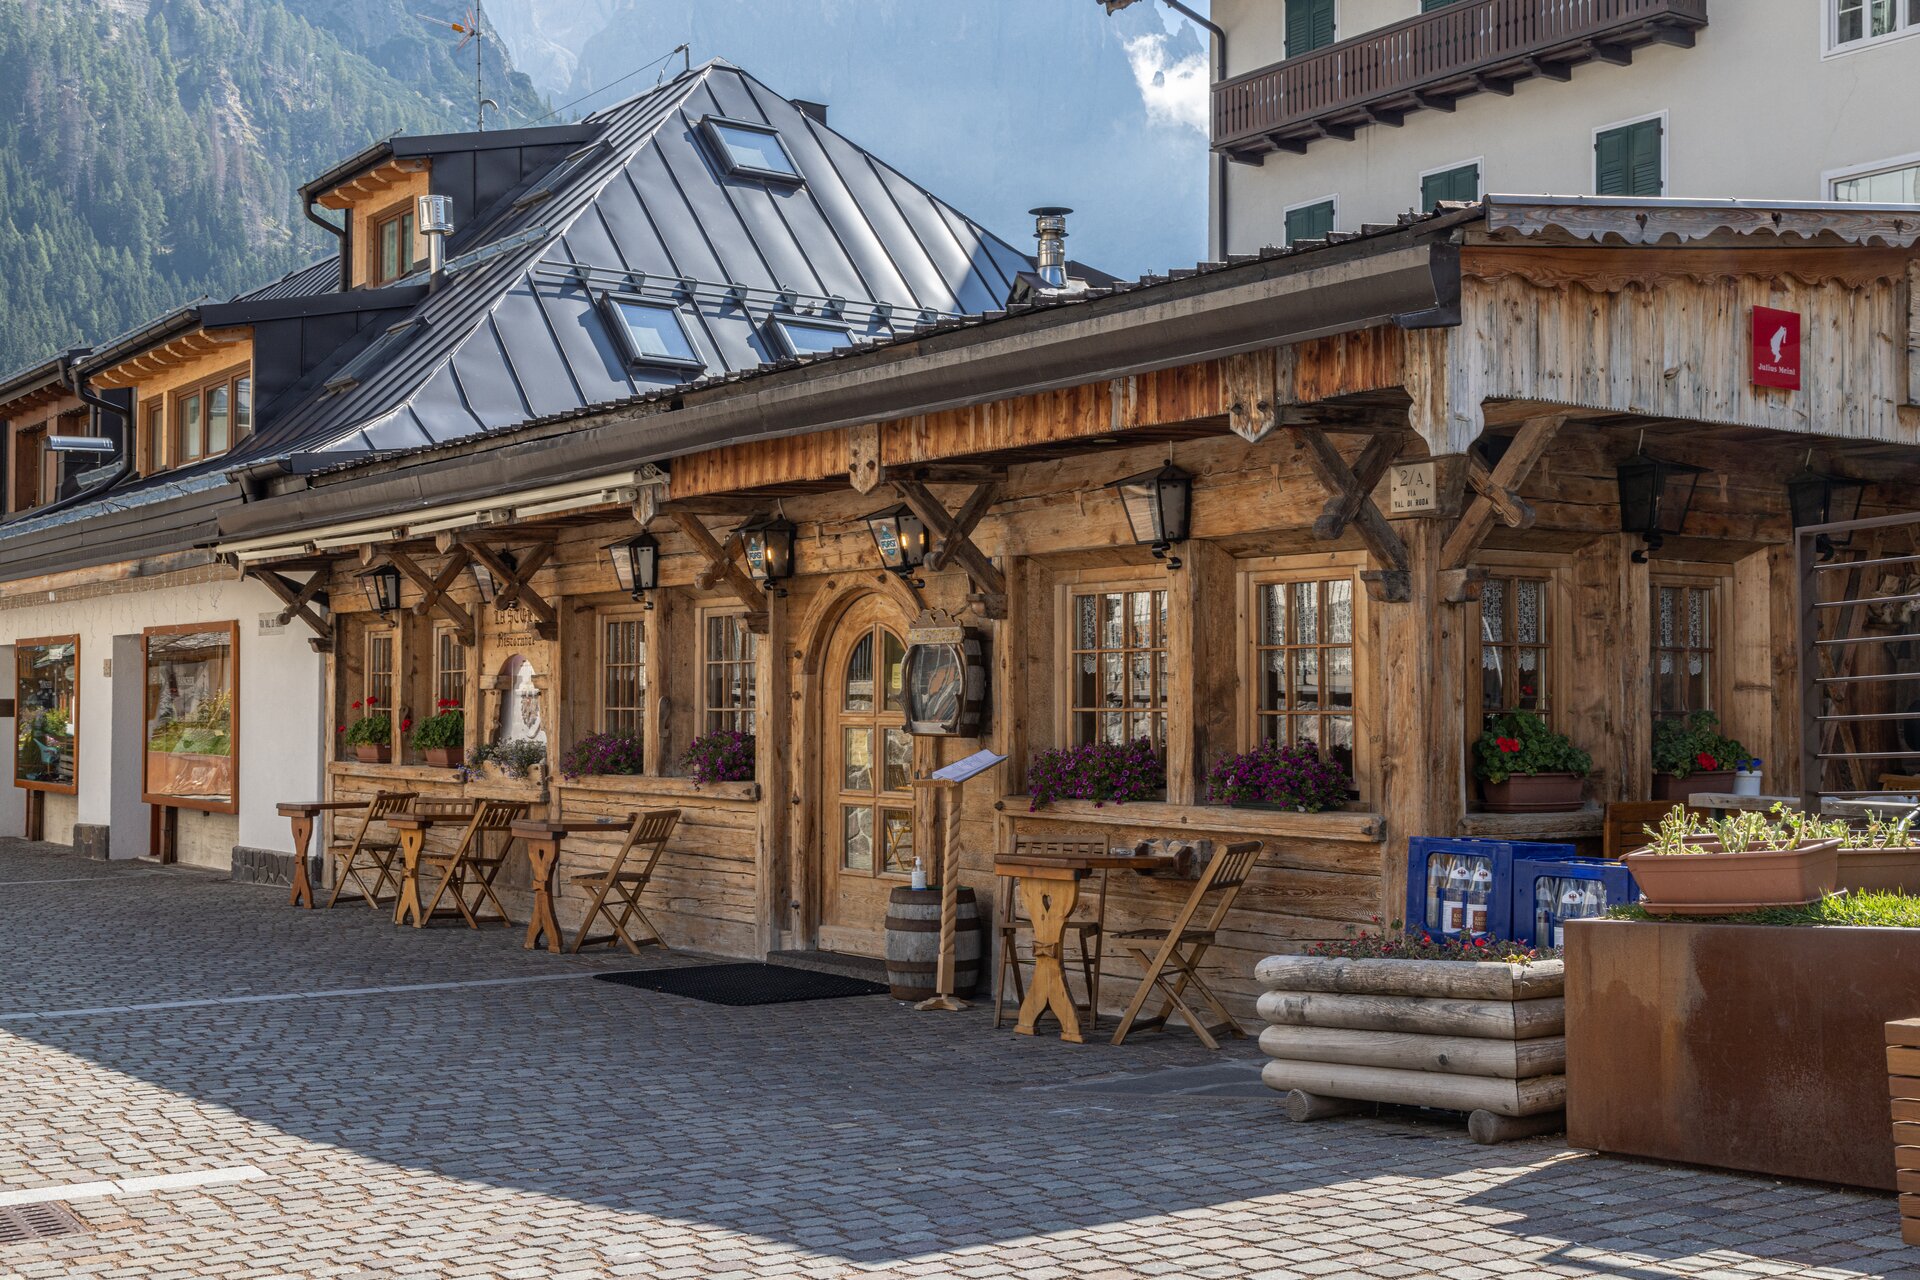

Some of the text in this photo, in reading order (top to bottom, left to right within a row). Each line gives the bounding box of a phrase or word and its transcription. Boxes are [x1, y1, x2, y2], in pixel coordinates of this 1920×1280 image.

[1758, 363, 1796, 376] Julius Meinl
[1400, 469, 1424, 487] 2/A
[1407, 489, 1417, 497] VIA
[1394, 500, 1404, 508] VAL
